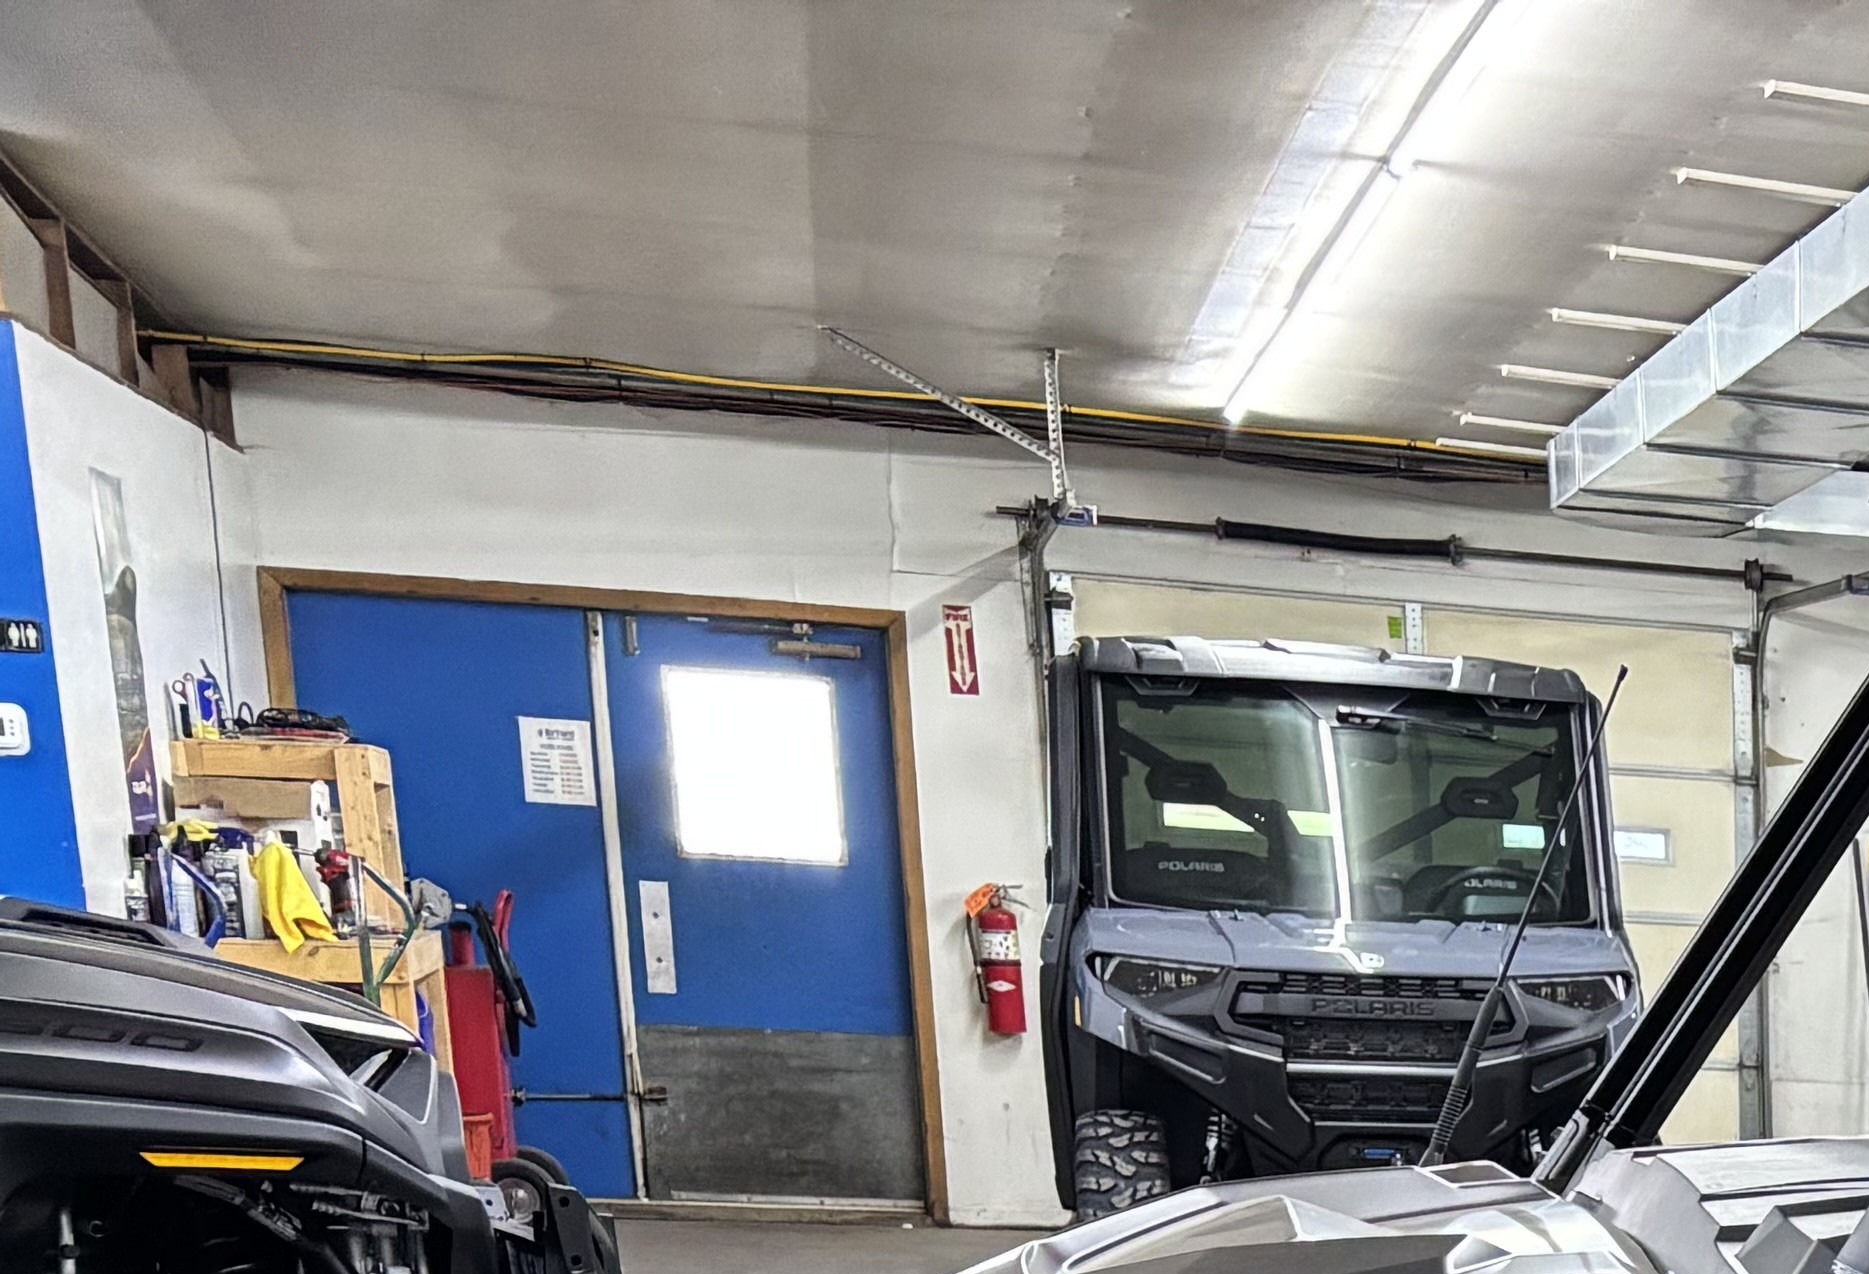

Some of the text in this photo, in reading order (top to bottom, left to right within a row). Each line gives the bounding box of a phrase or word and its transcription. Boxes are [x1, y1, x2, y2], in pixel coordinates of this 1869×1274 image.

[1158, 861, 1224, 872] POLARIS
[1464, 878, 1517, 889] OLARIS
[1311, 998, 1434, 1016] POLARIS
